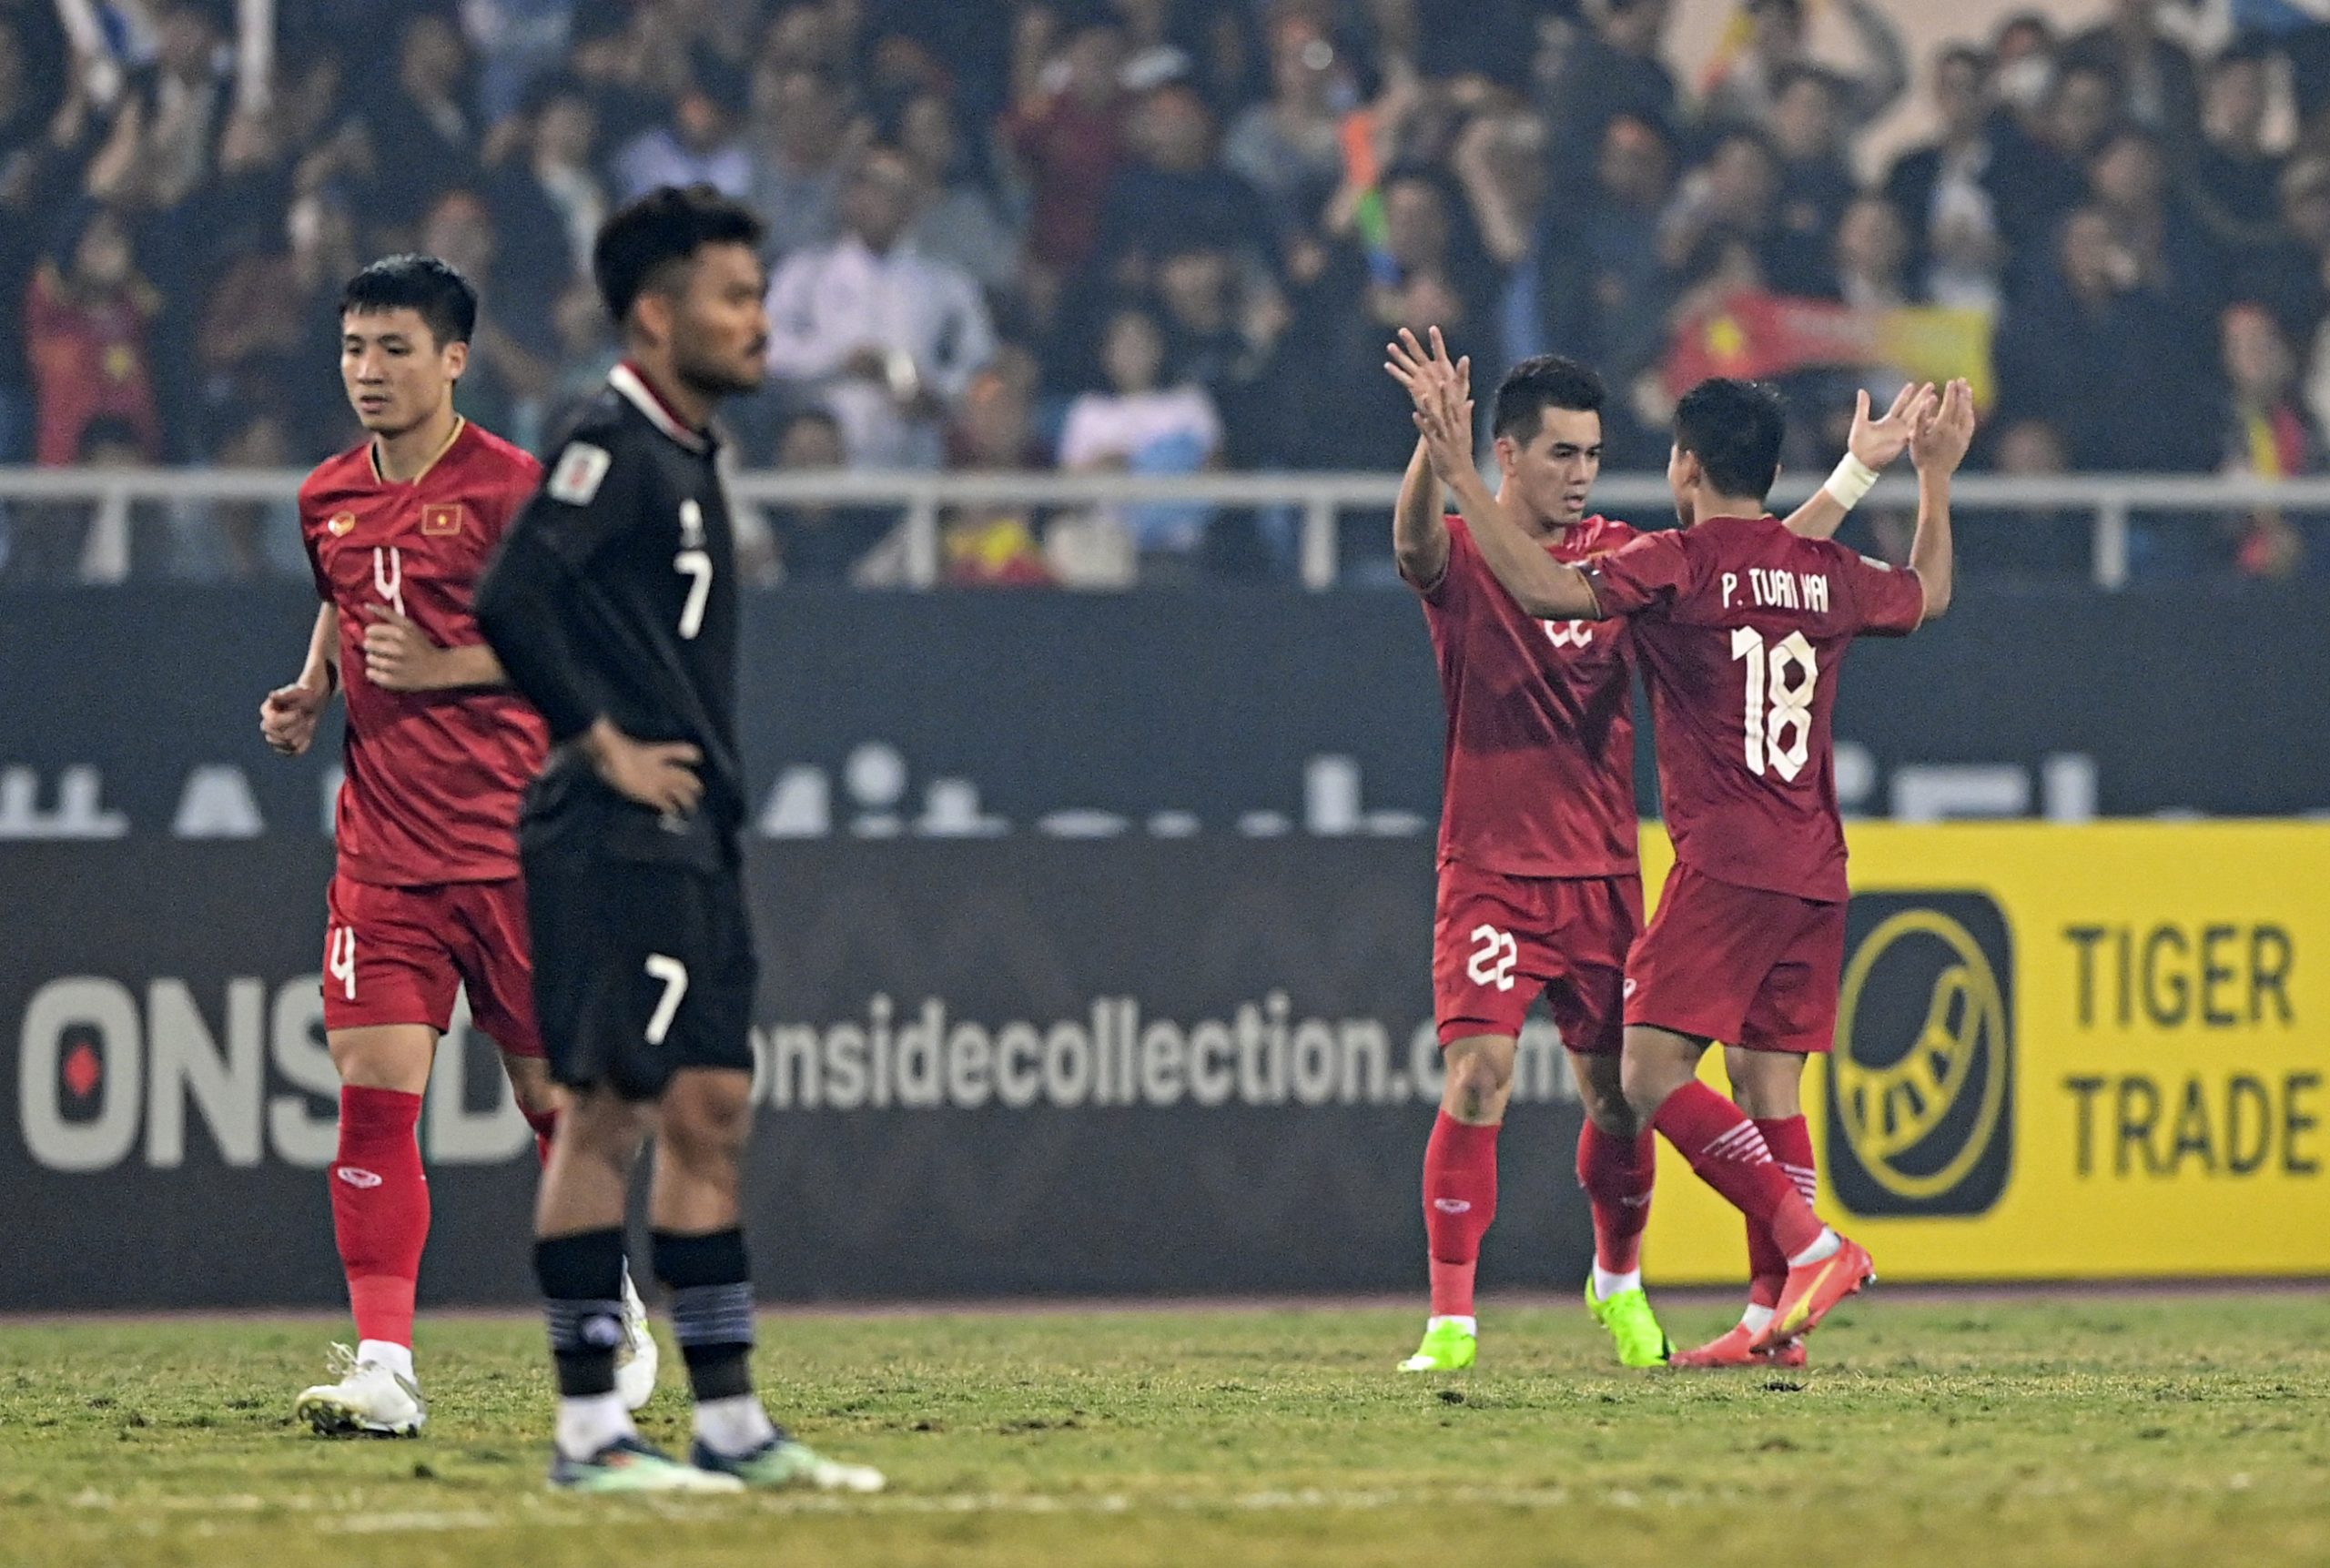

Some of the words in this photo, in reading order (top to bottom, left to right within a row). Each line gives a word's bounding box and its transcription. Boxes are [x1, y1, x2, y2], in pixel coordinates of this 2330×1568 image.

[374, 546, 405, 616] 4
[673, 550, 713, 640] 7
[1721, 572, 1743, 609] P.
[1748, 568, 1799, 610] TUAN
[1731, 625, 1818, 783] 18
[329, 926, 356, 999] 4
[644, 952, 688, 1046] 7
[1467, 924, 1517, 992] 22
[2060, 922, 2295, 1029] TIGER
[18, 976, 537, 1171] ONSD
[2060, 1071, 2323, 1179] TRADE
